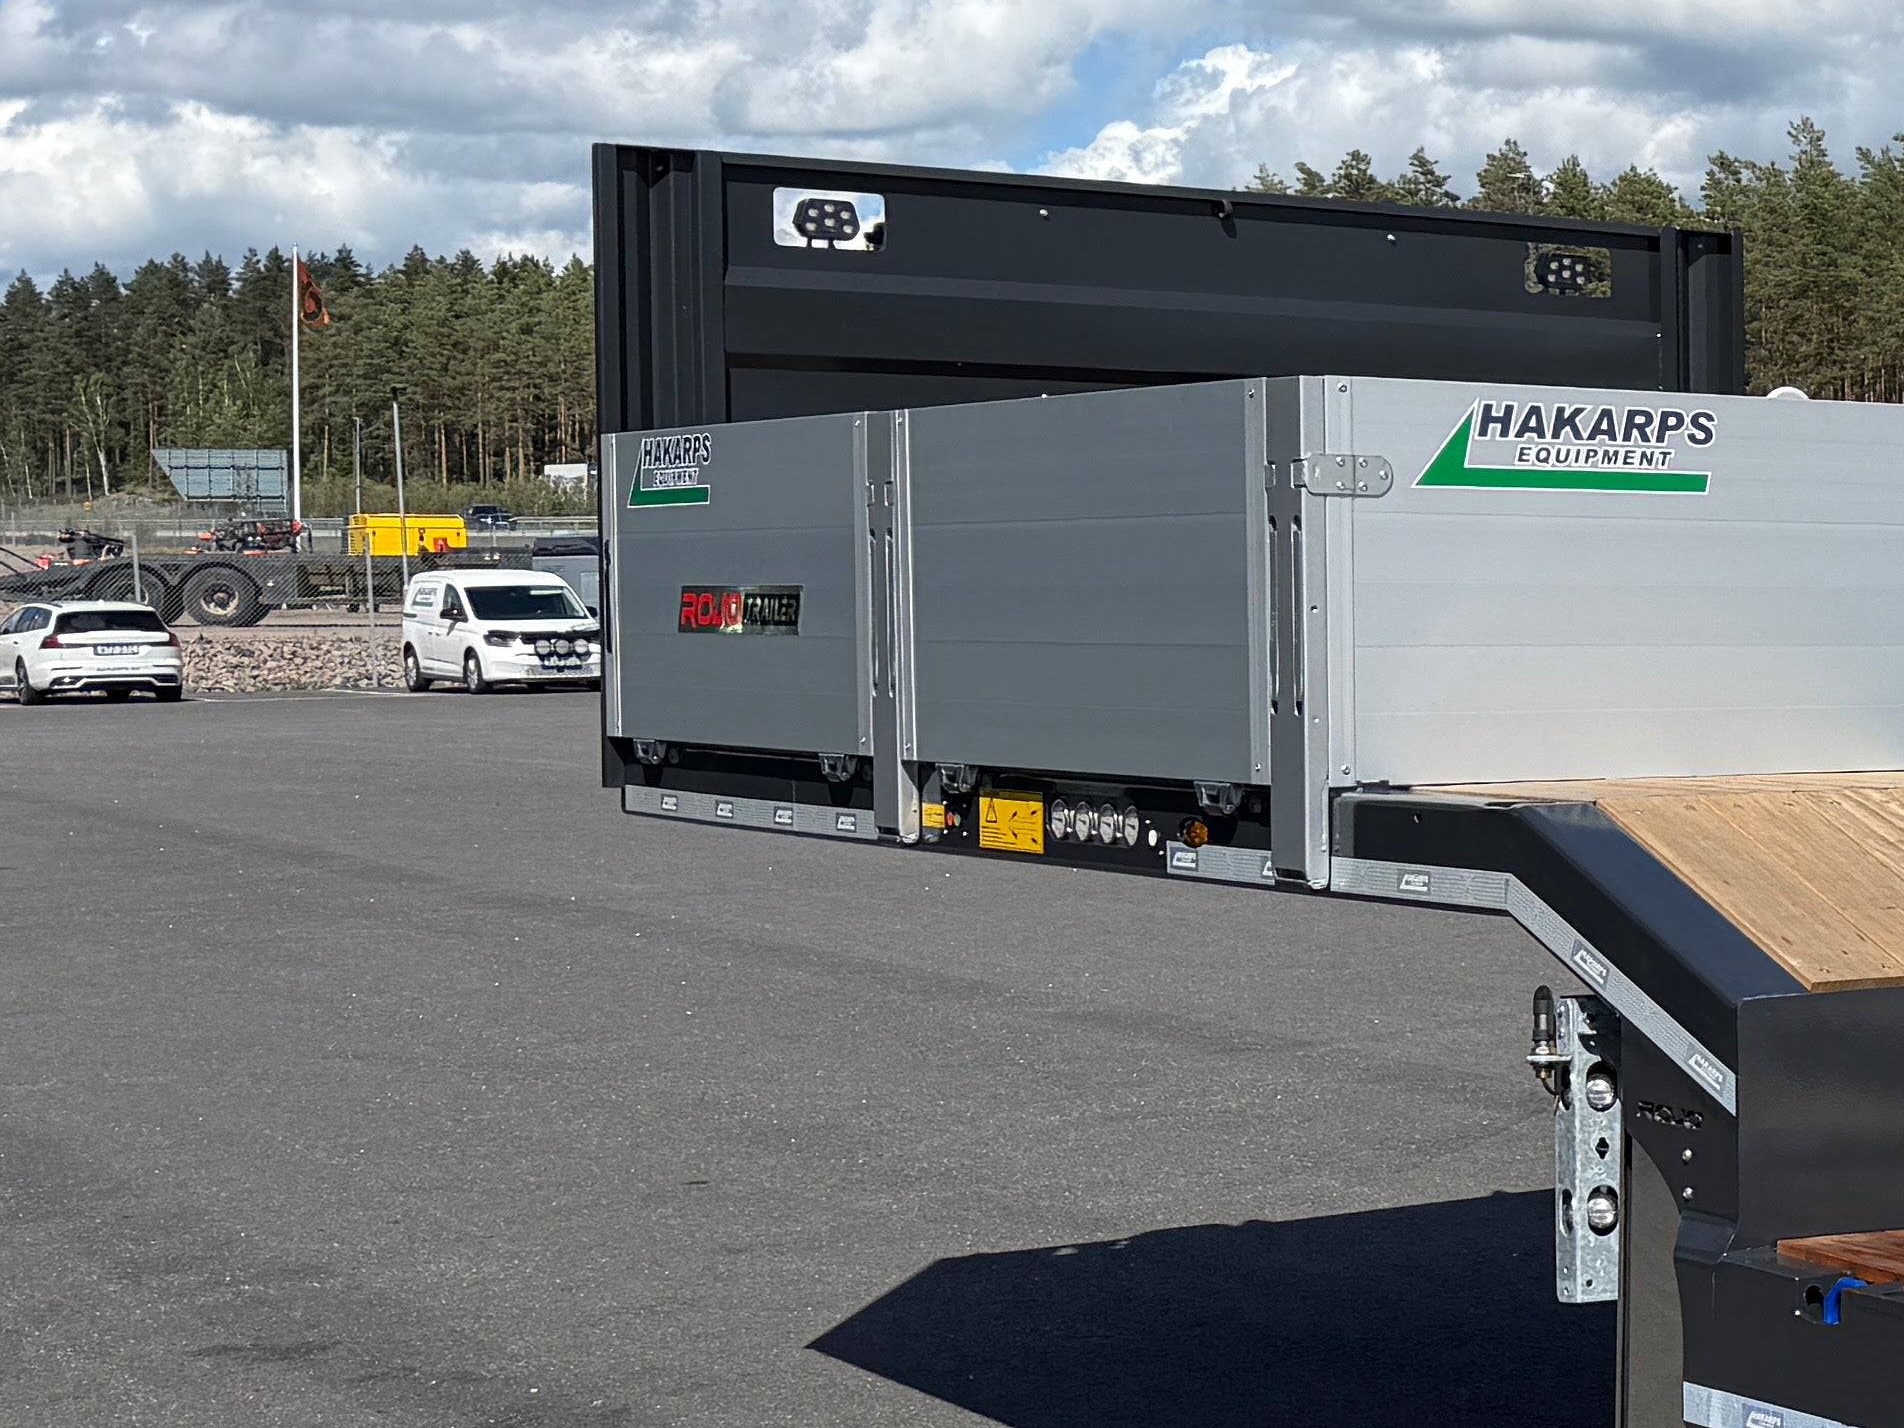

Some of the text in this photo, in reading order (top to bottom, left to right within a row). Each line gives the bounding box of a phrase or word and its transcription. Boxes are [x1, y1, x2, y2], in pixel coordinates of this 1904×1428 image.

[1476, 402, 1717, 447] HAKARPS
[642, 434, 711, 467] HAKARPS
[1516, 446, 1673, 467] EQUIPMENT
